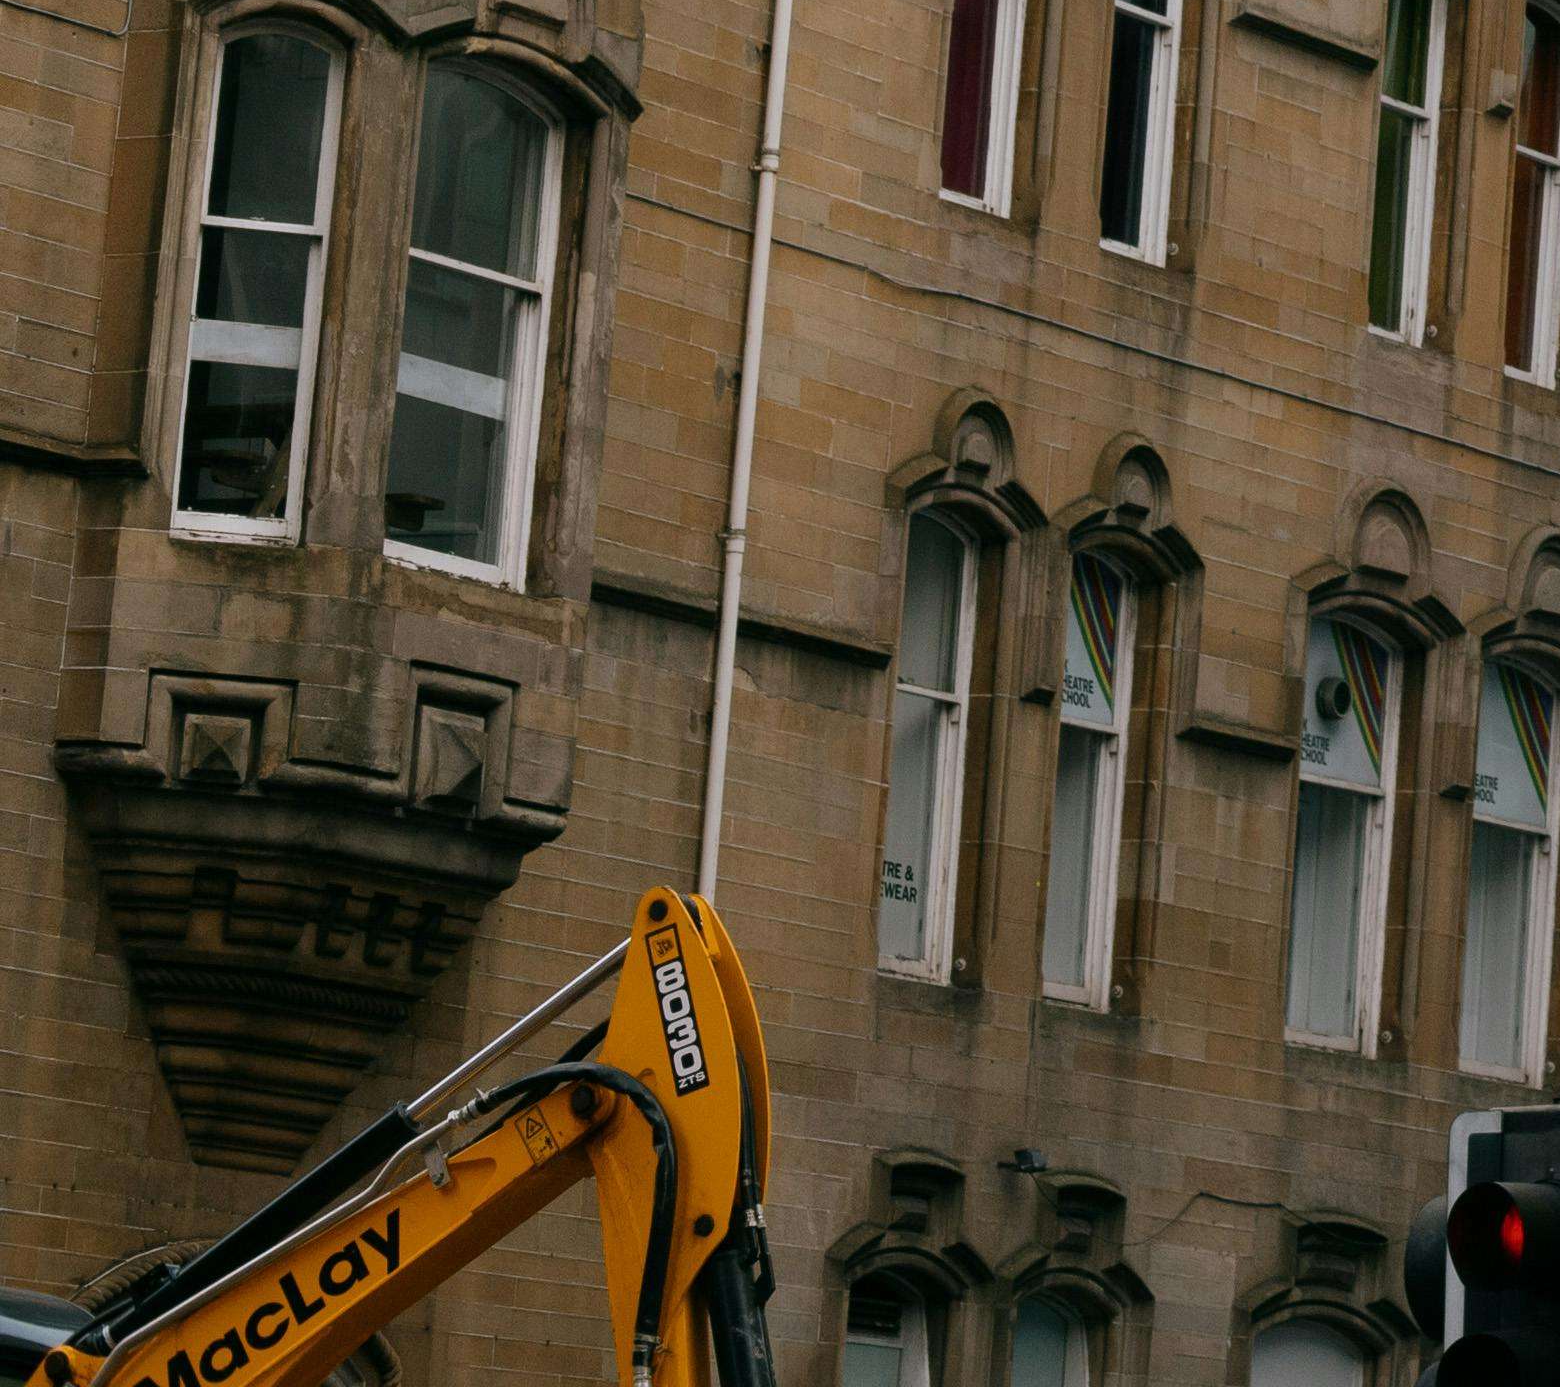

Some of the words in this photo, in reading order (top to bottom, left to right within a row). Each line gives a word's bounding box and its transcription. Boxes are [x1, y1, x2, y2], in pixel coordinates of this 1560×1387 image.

[904, 865, 914, 881] &
[655, 960, 703, 1077] 8030
[678, 1070, 706, 1090] ZTS
[133, 1208, 400, 1387] MacLay
